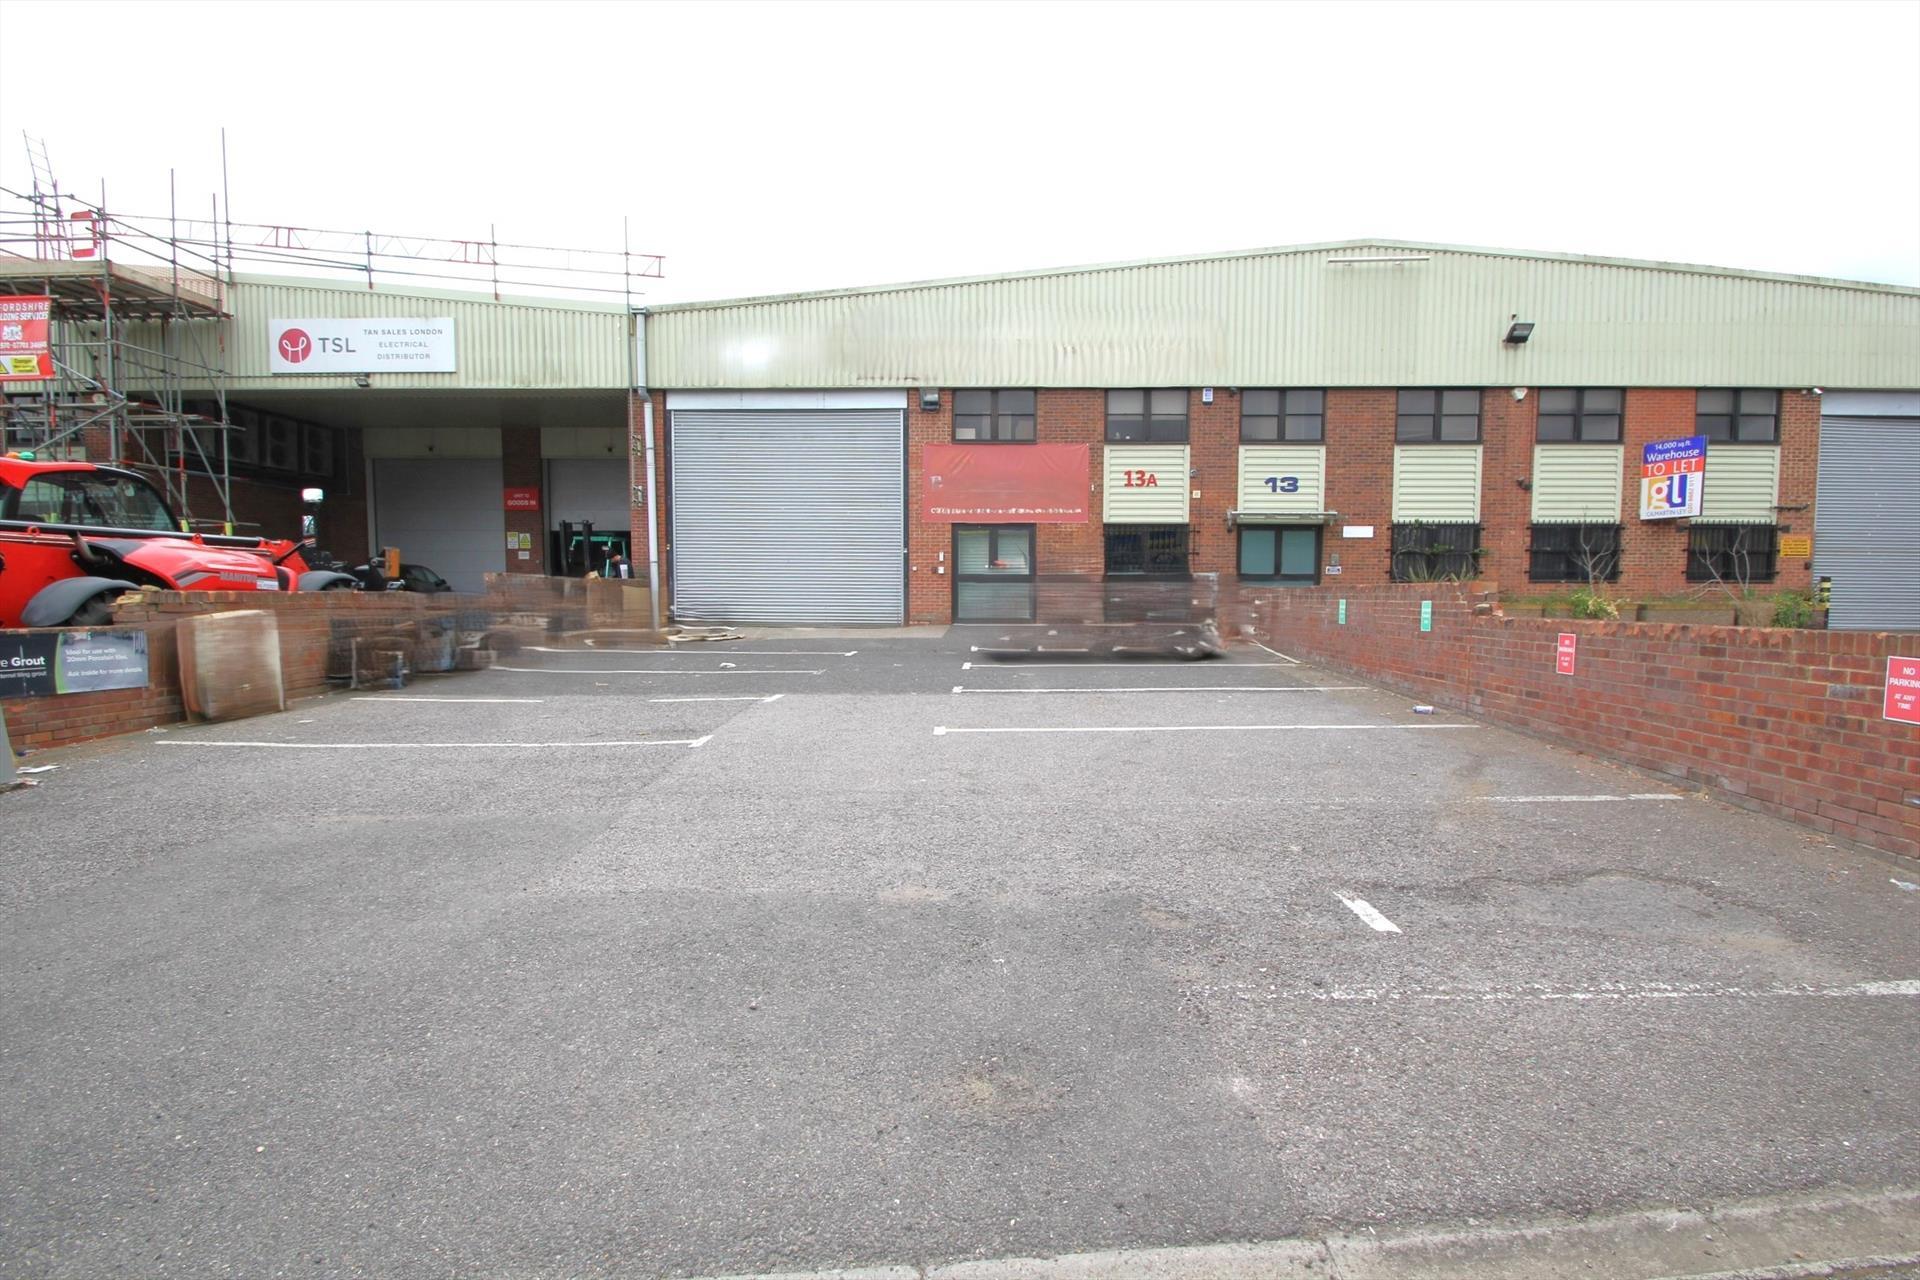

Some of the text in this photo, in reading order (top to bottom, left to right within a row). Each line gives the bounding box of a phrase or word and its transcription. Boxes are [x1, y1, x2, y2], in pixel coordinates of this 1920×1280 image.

[318, 337, 356, 353] TSL
[1647, 448, 1700, 462] Warehouse
[1645, 458, 1699, 477] TO LET
[1123, 470, 1158, 487] 13A
[1264, 476, 1299, 493] 13
[11, 656, 46, 667] Grout
[1903, 667, 1916, 676] NO
